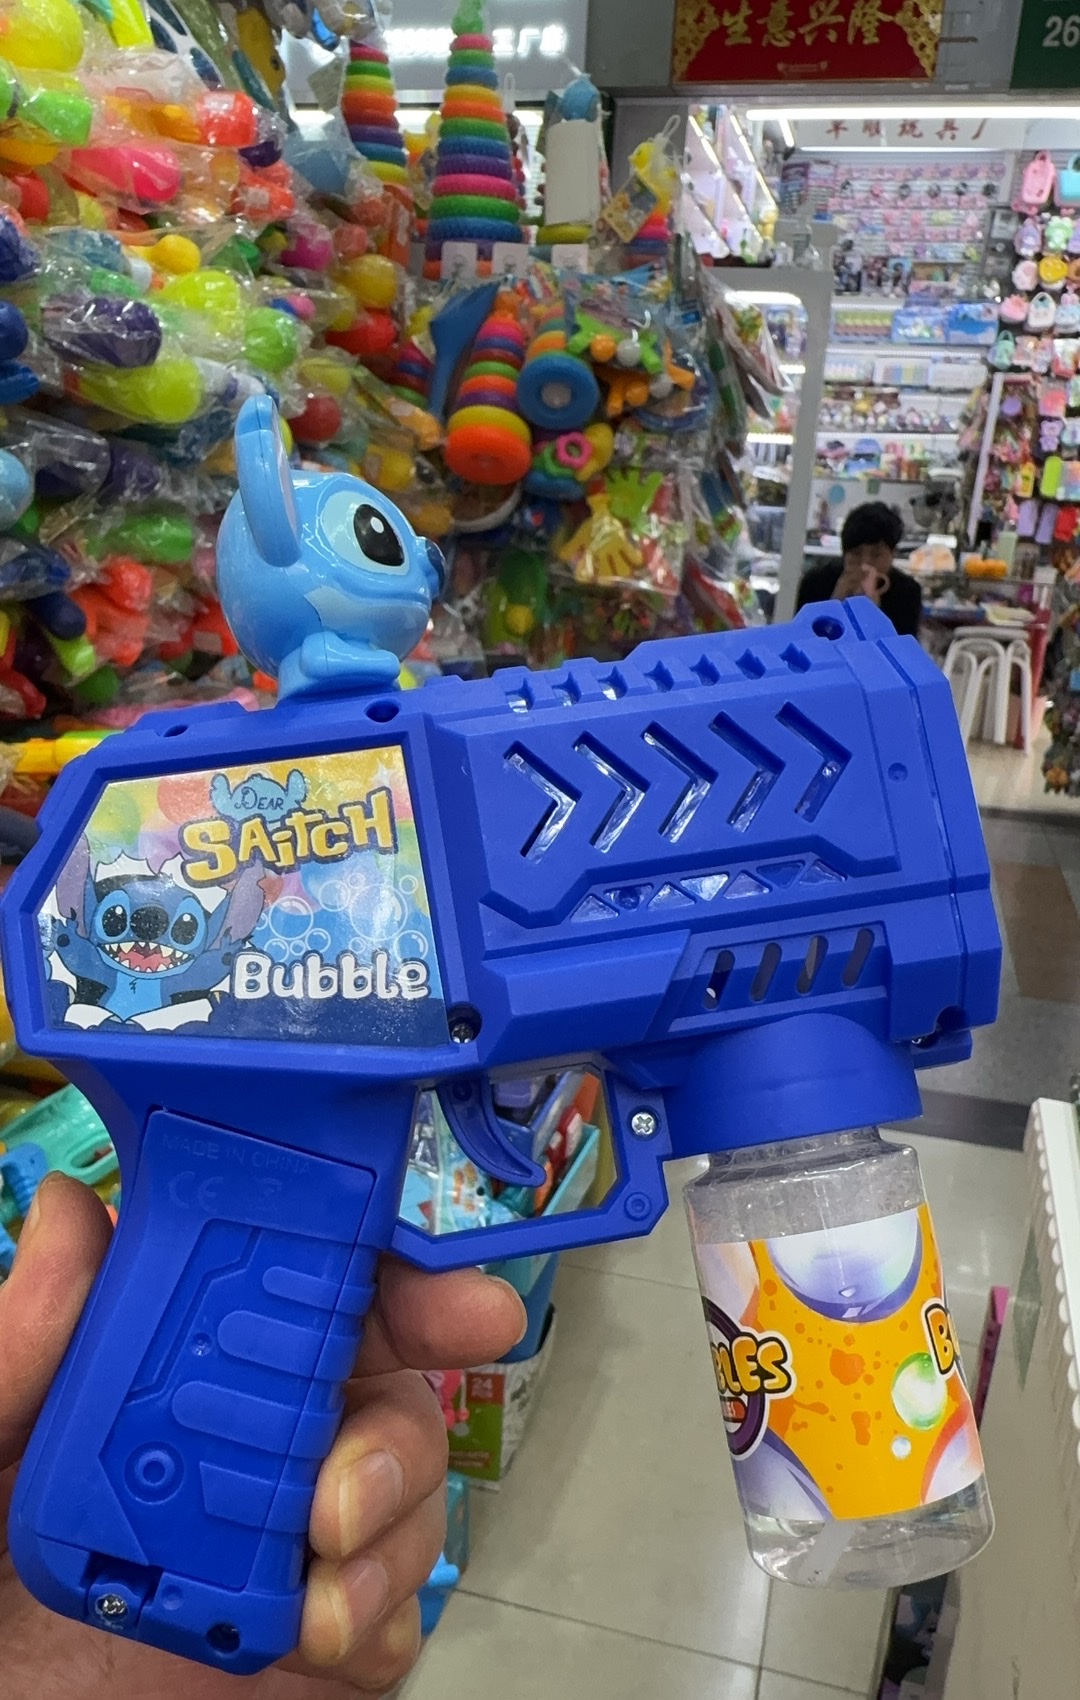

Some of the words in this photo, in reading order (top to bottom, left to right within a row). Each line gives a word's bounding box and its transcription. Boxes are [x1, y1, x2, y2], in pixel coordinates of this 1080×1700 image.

[722, 0, 895, 47] 生意兴隆
[232, 949, 430, 1002] Bubble
[162, 1133, 220, 1161] MADE
[226, 1147, 247, 1165] IN
[251, 1151, 312, 1176] CHINA
